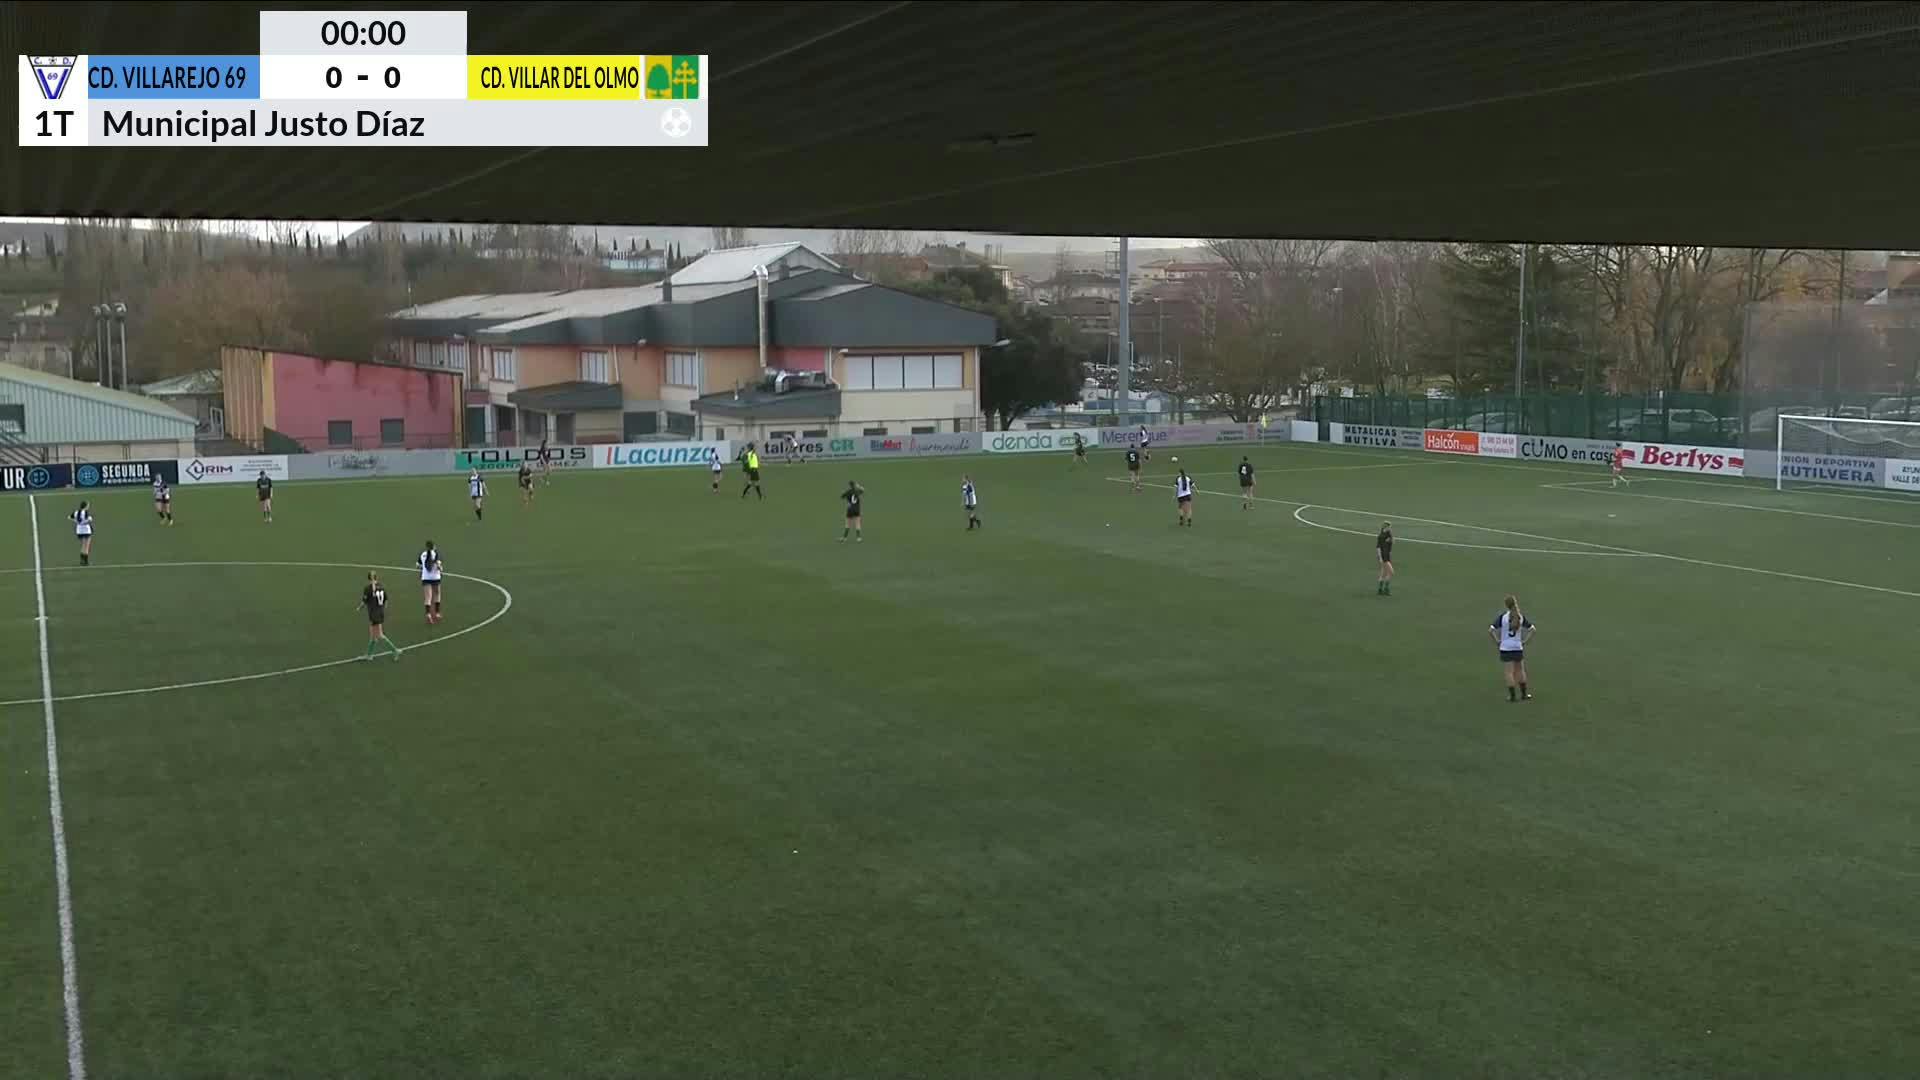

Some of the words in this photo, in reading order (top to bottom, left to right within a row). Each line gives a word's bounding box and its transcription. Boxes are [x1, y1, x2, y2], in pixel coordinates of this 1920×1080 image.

[992, 432, 1052, 451] denda
[1344, 435, 1397, 447] MUTILVA
[462, 447, 586, 464] TOLDOS
[1571, 449, 1586, 460] en
[1640, 445, 1724, 470] Berlys
[102, 464, 151, 479] SEGUNDA
[1815, 459, 1876, 468] DEPORTIVA
[0, 467, 26, 489] UR
